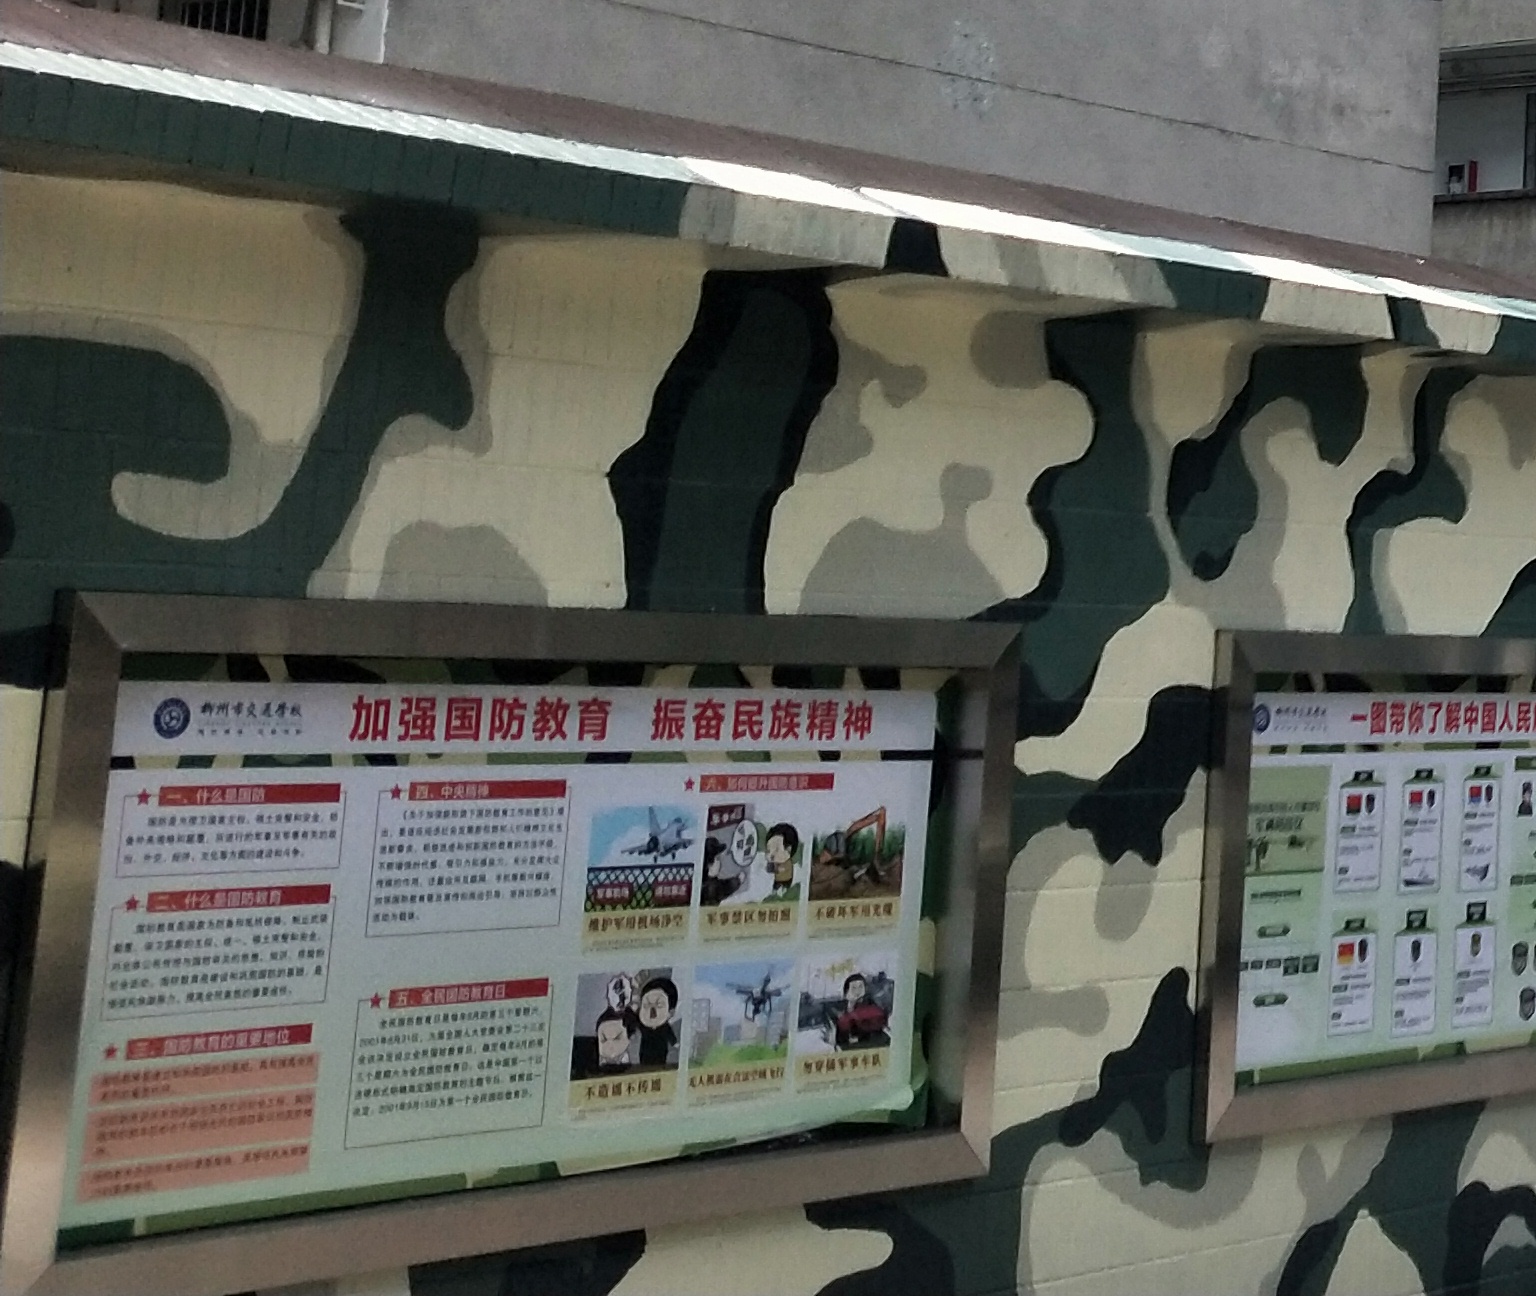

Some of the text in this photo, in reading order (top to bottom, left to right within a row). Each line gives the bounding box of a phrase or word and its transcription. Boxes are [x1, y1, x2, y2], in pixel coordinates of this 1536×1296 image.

[348, 695, 874, 742] 加强国防教育 振奋民族精神
